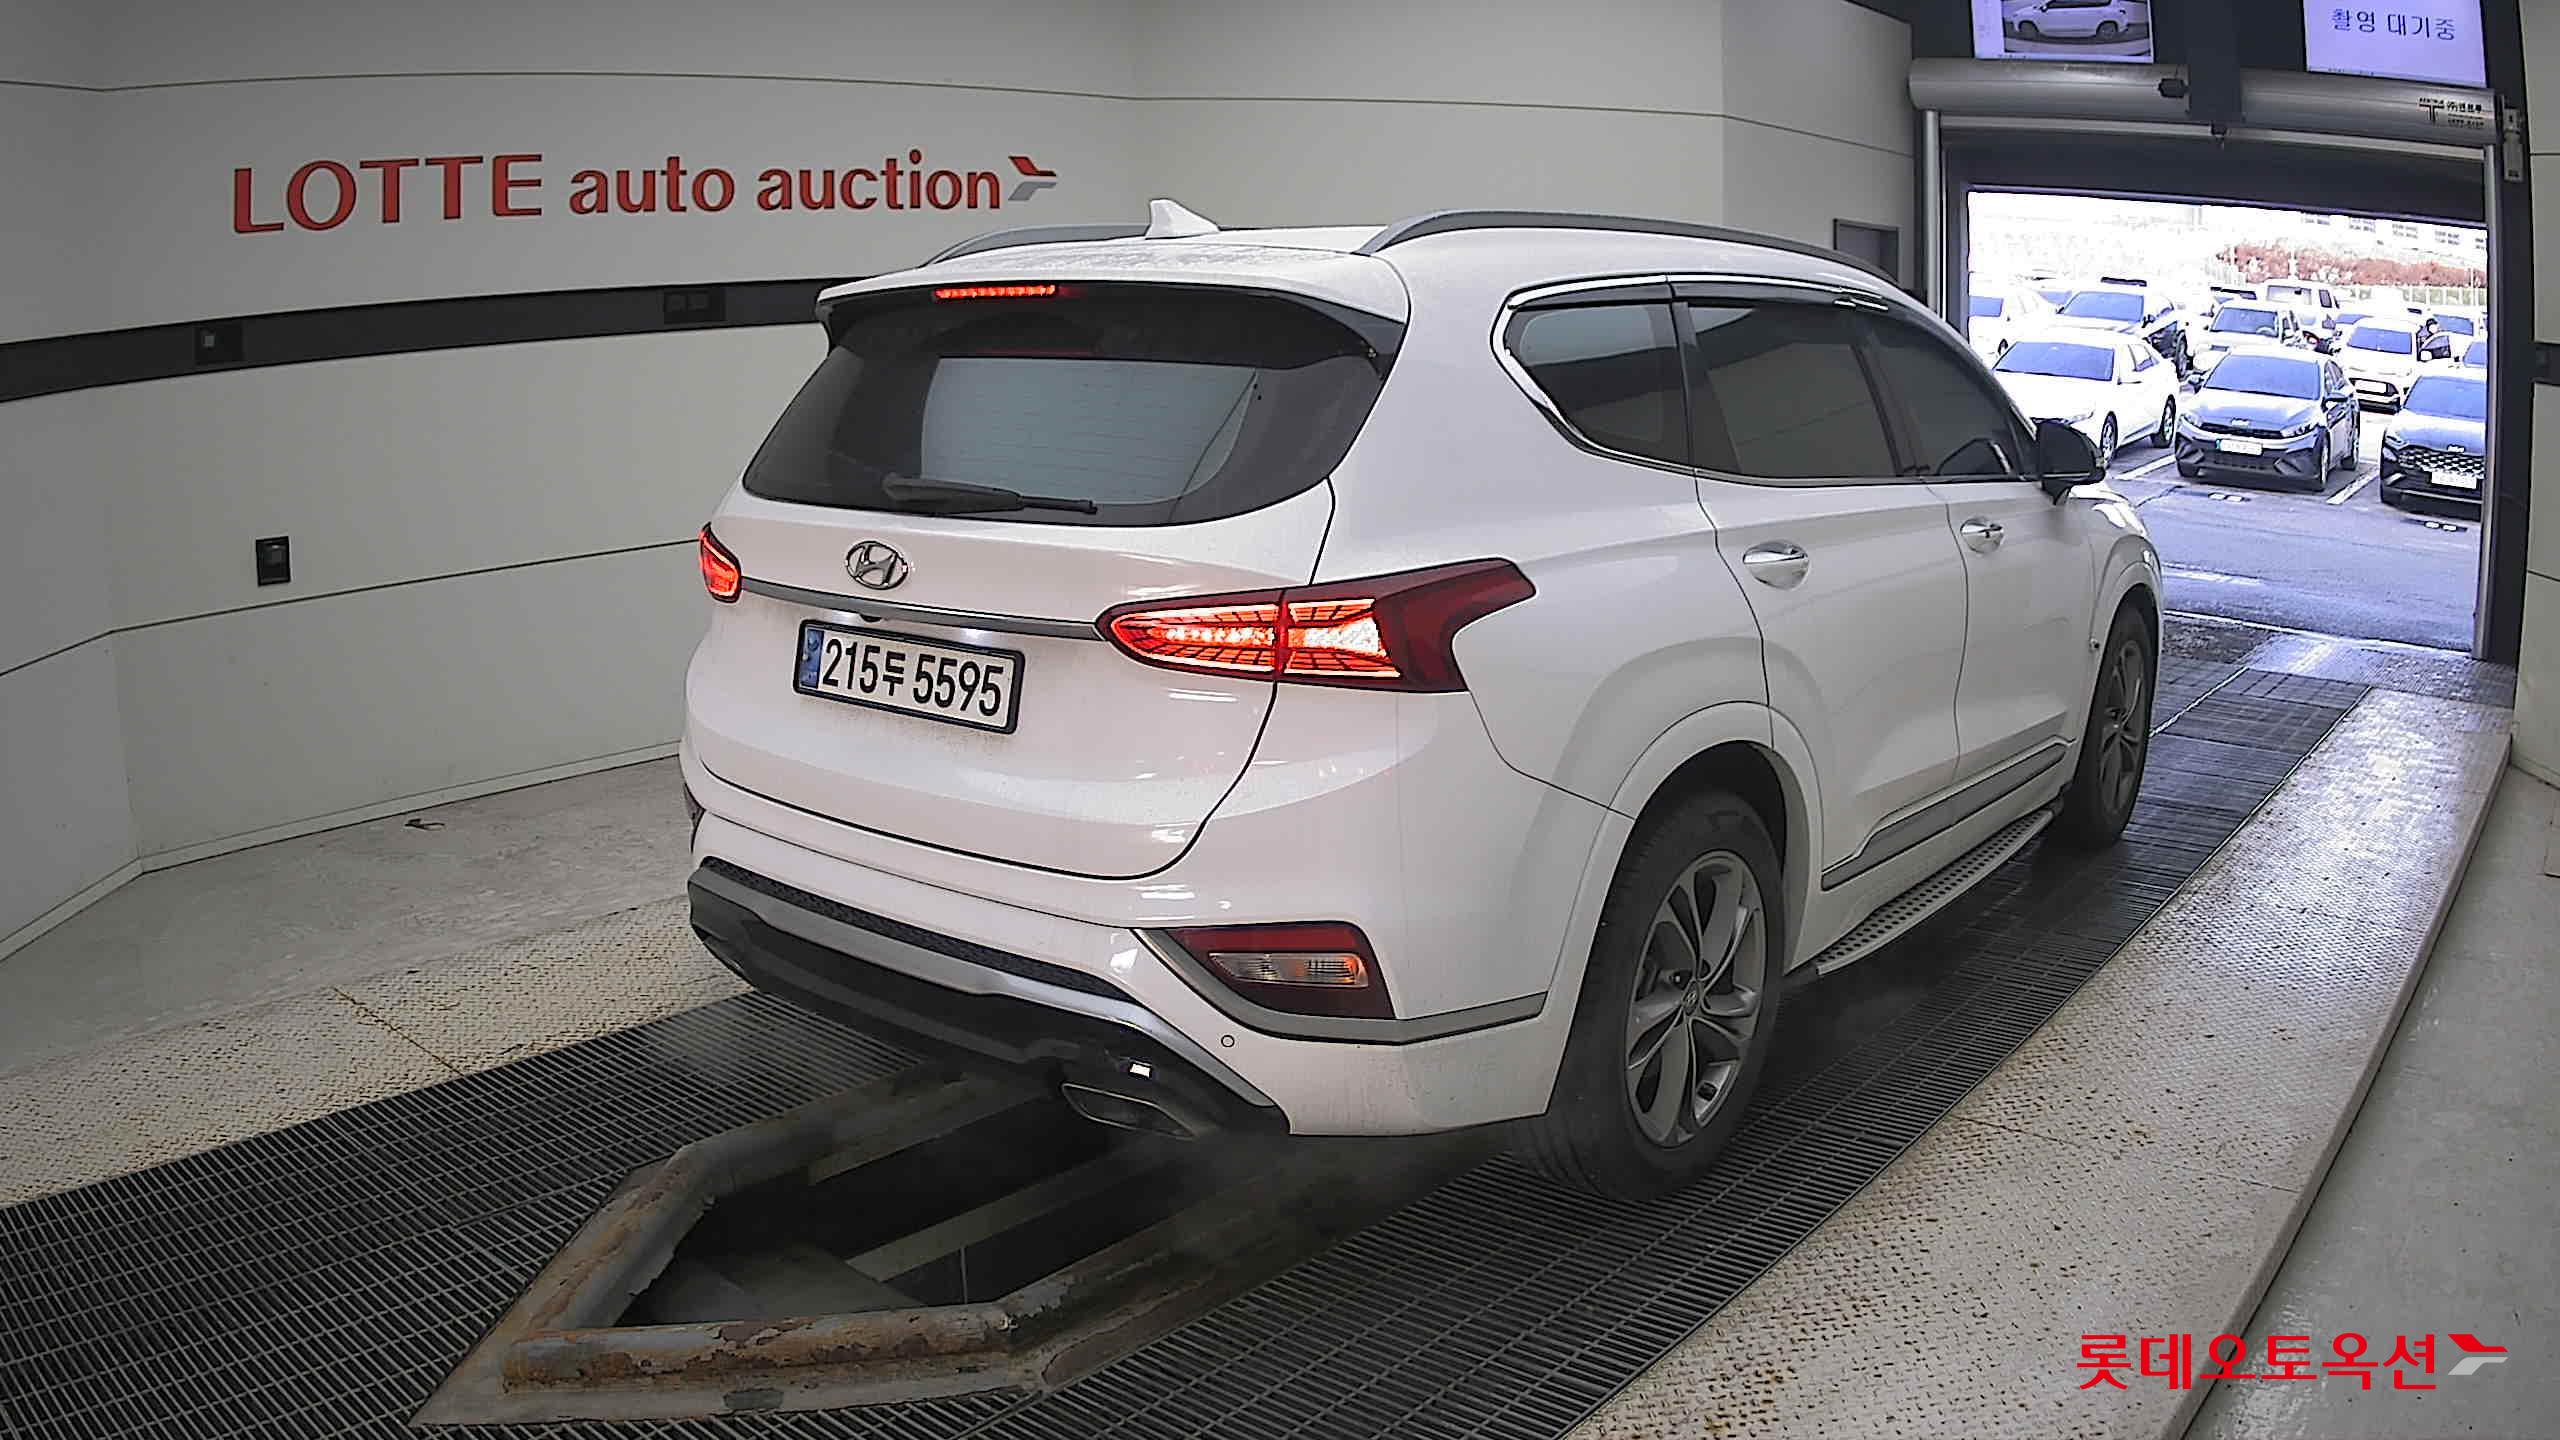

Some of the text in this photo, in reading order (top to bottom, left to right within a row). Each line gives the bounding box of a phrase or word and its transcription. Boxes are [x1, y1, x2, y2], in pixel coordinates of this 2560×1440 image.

[2332, 8, 2456, 40] 촬영 대기중
[234, 150, 1001, 234] LOTTE auto auction
[821, 638, 1004, 716] 215두 5595
